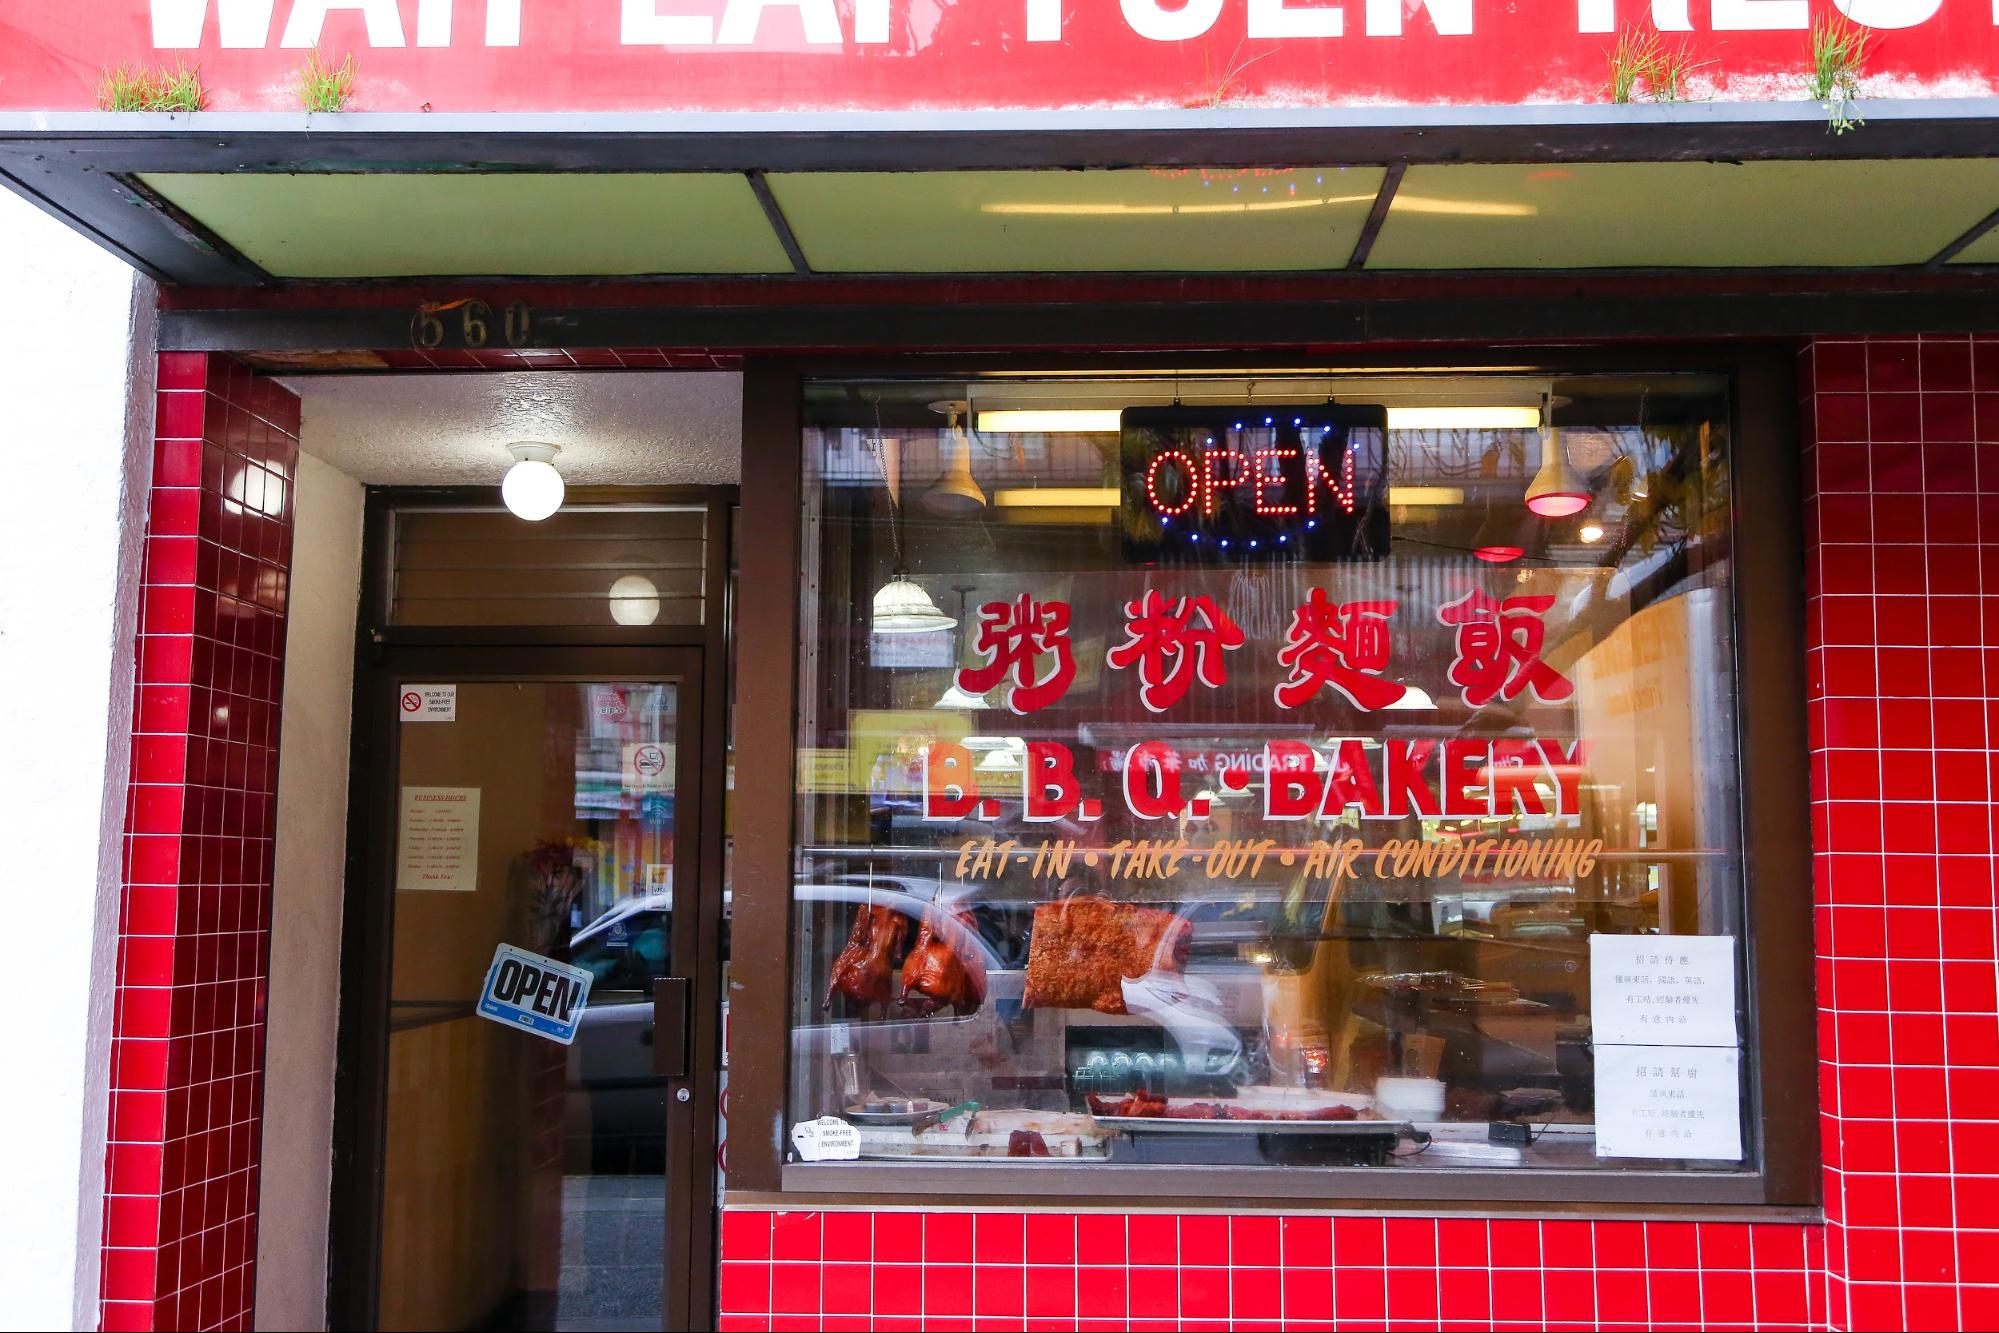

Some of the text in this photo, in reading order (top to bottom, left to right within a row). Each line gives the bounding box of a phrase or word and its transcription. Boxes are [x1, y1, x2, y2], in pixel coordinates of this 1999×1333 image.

[417, 299, 531, 347] 560
[1145, 447, 1356, 517] OPEN
[1264, 738, 1596, 823] BAKERY
[956, 838, 1076, 880] EAT-IN
[1305, 838, 1365, 881] AIR
[1373, 837, 1604, 881] CONDITIONING
[493, 958, 582, 1023] OPEN
[817, 1118, 839, 1126] WELCOME
